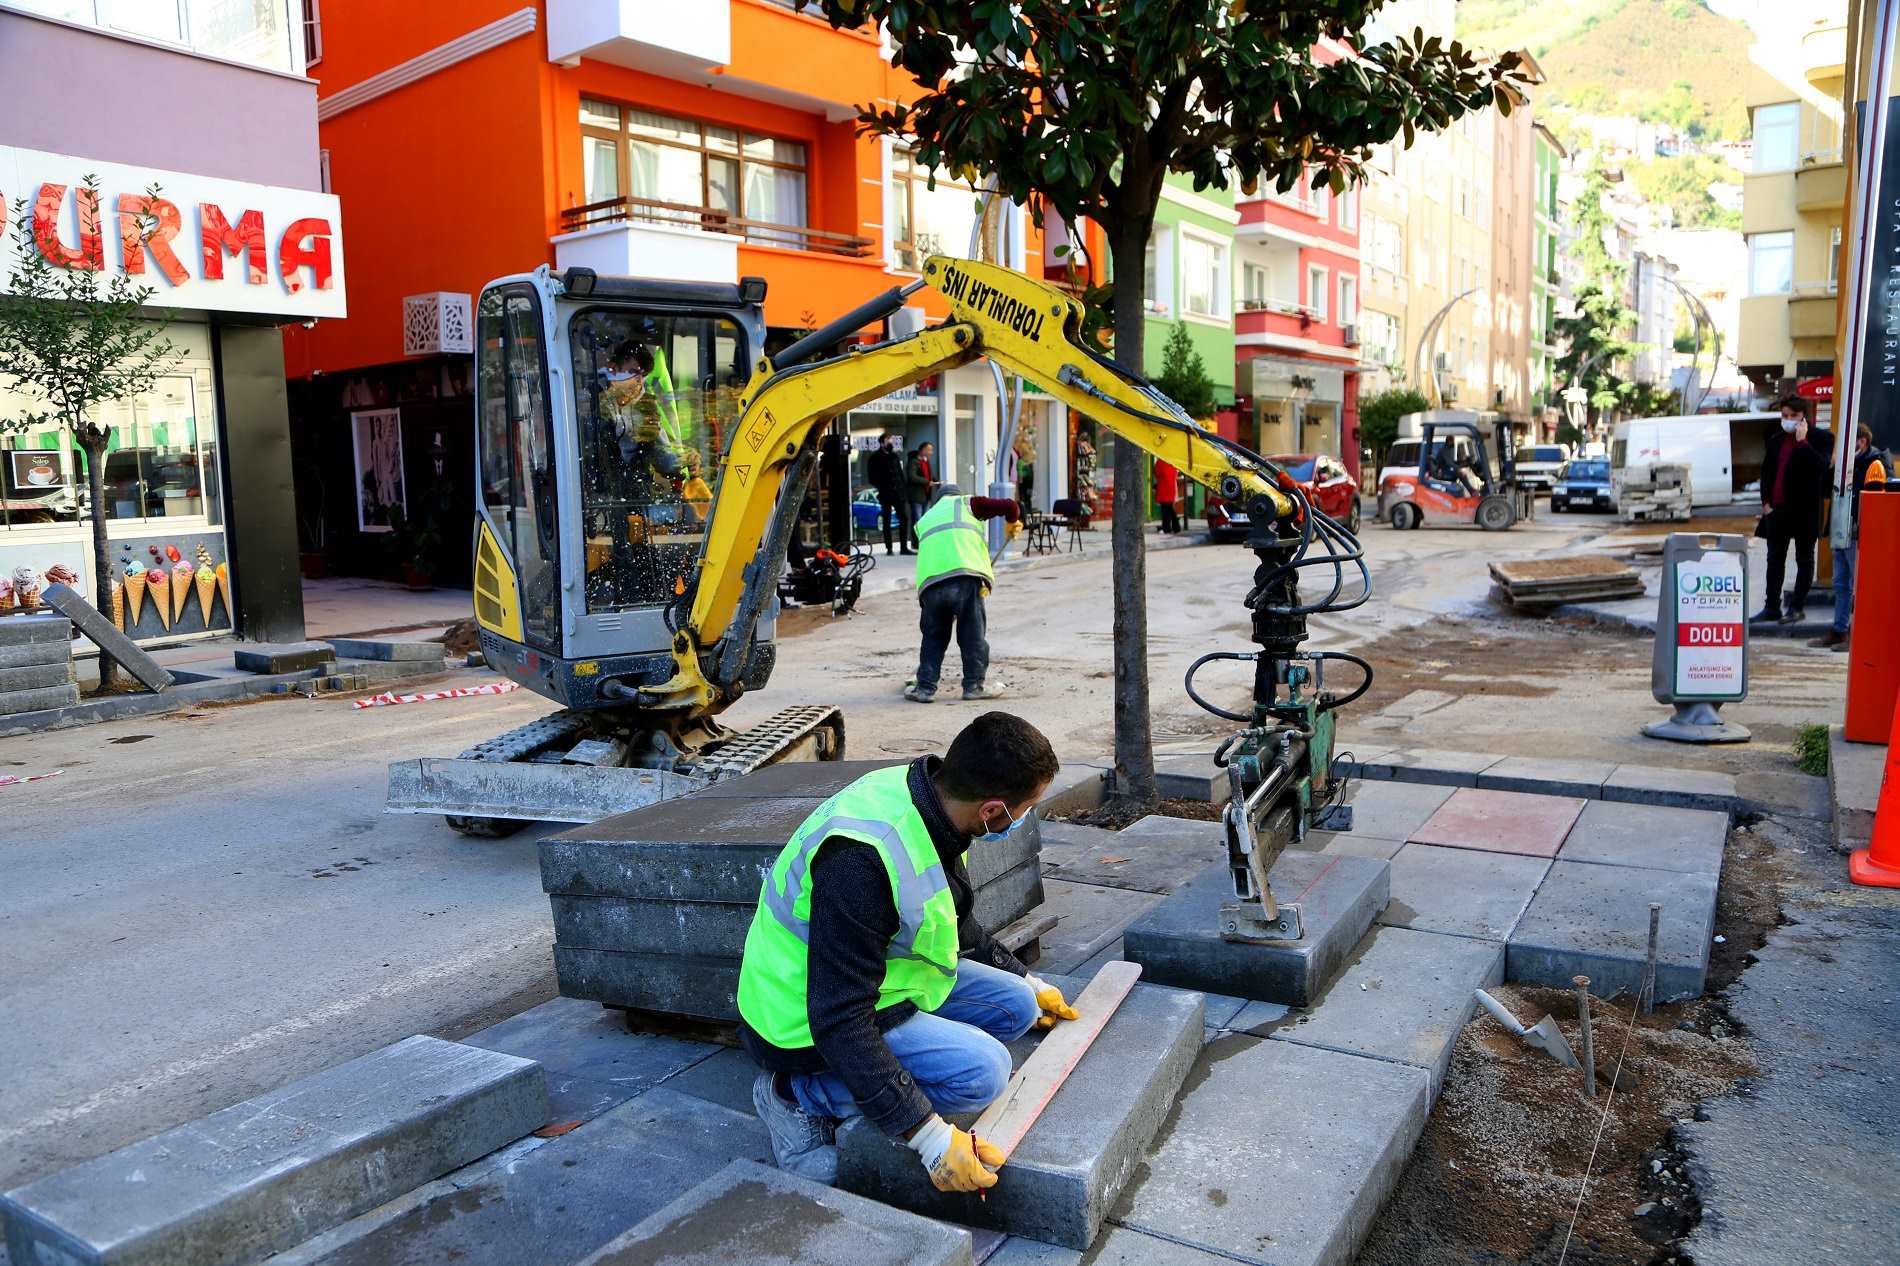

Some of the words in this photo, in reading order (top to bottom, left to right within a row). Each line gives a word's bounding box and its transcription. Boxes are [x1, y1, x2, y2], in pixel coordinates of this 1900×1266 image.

[0, 183, 333, 295] URMA
[968, 279, 1044, 342] TORUNLAR
[1882, 265, 1900, 385] RESTAURANT
[1681, 597, 1739, 605] OTOPARK
[1689, 627, 1733, 643] DOLU
